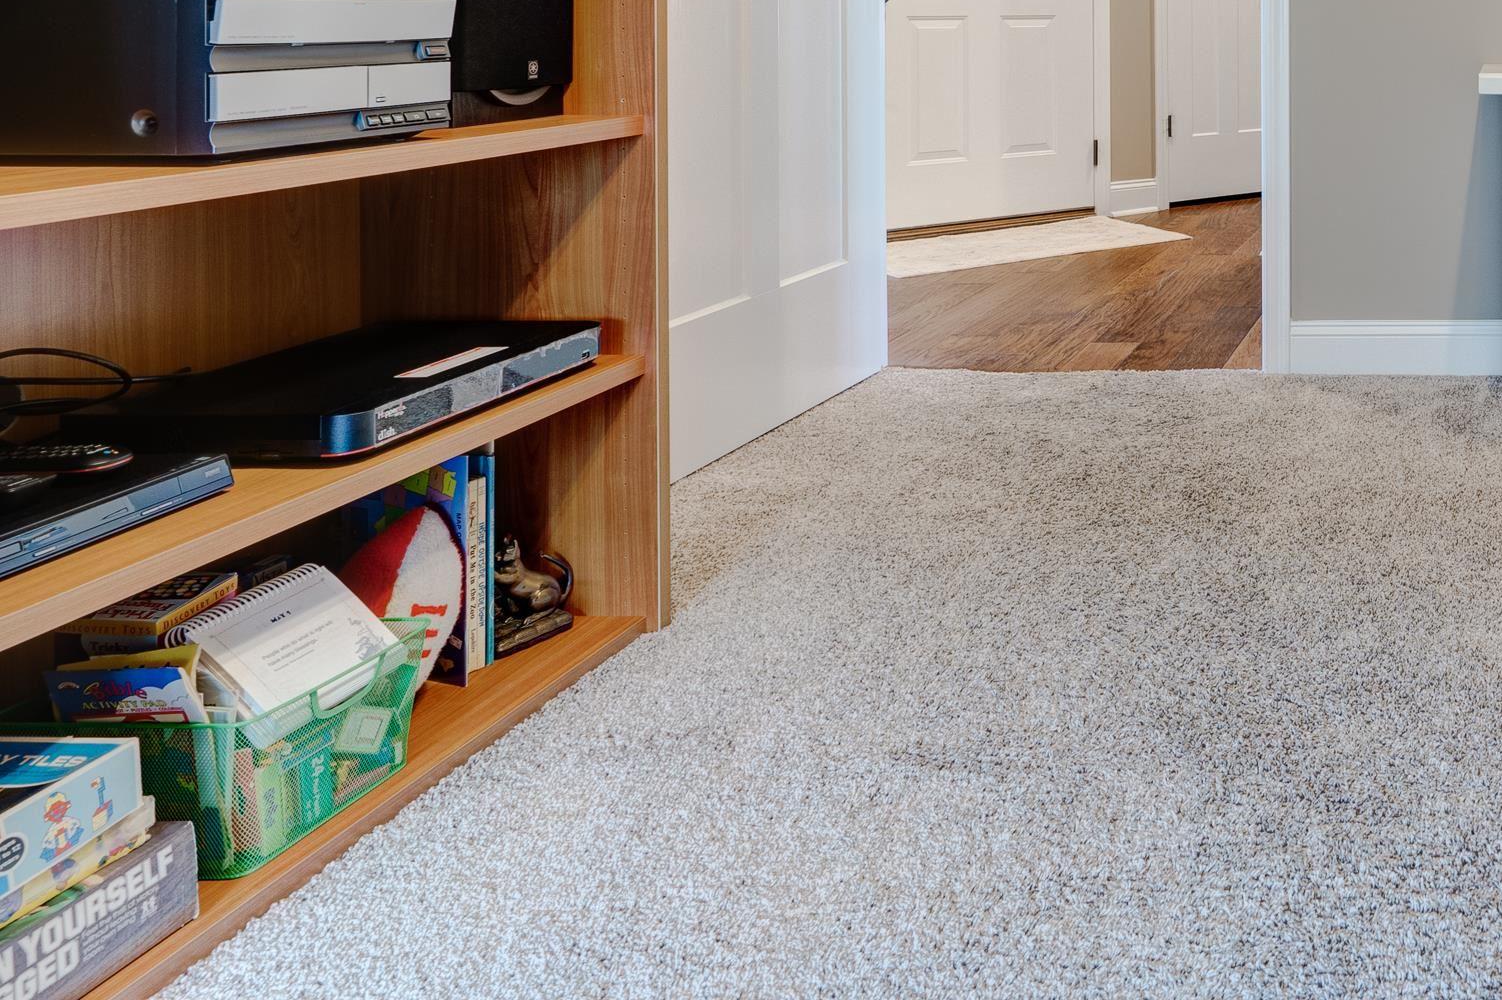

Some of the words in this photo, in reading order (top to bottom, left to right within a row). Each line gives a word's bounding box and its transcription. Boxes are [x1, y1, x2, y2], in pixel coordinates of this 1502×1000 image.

[470, 562, 476, 573] Me
[471, 576, 476, 585] in
[163, 599, 209, 631] DISCOVERY
[214, 582, 235, 601] TOYS
[83, 700, 138, 710] ACTIVITY
[19, 754, 88, 767] TILES
[17, 844, 174, 967] YOURSELF
